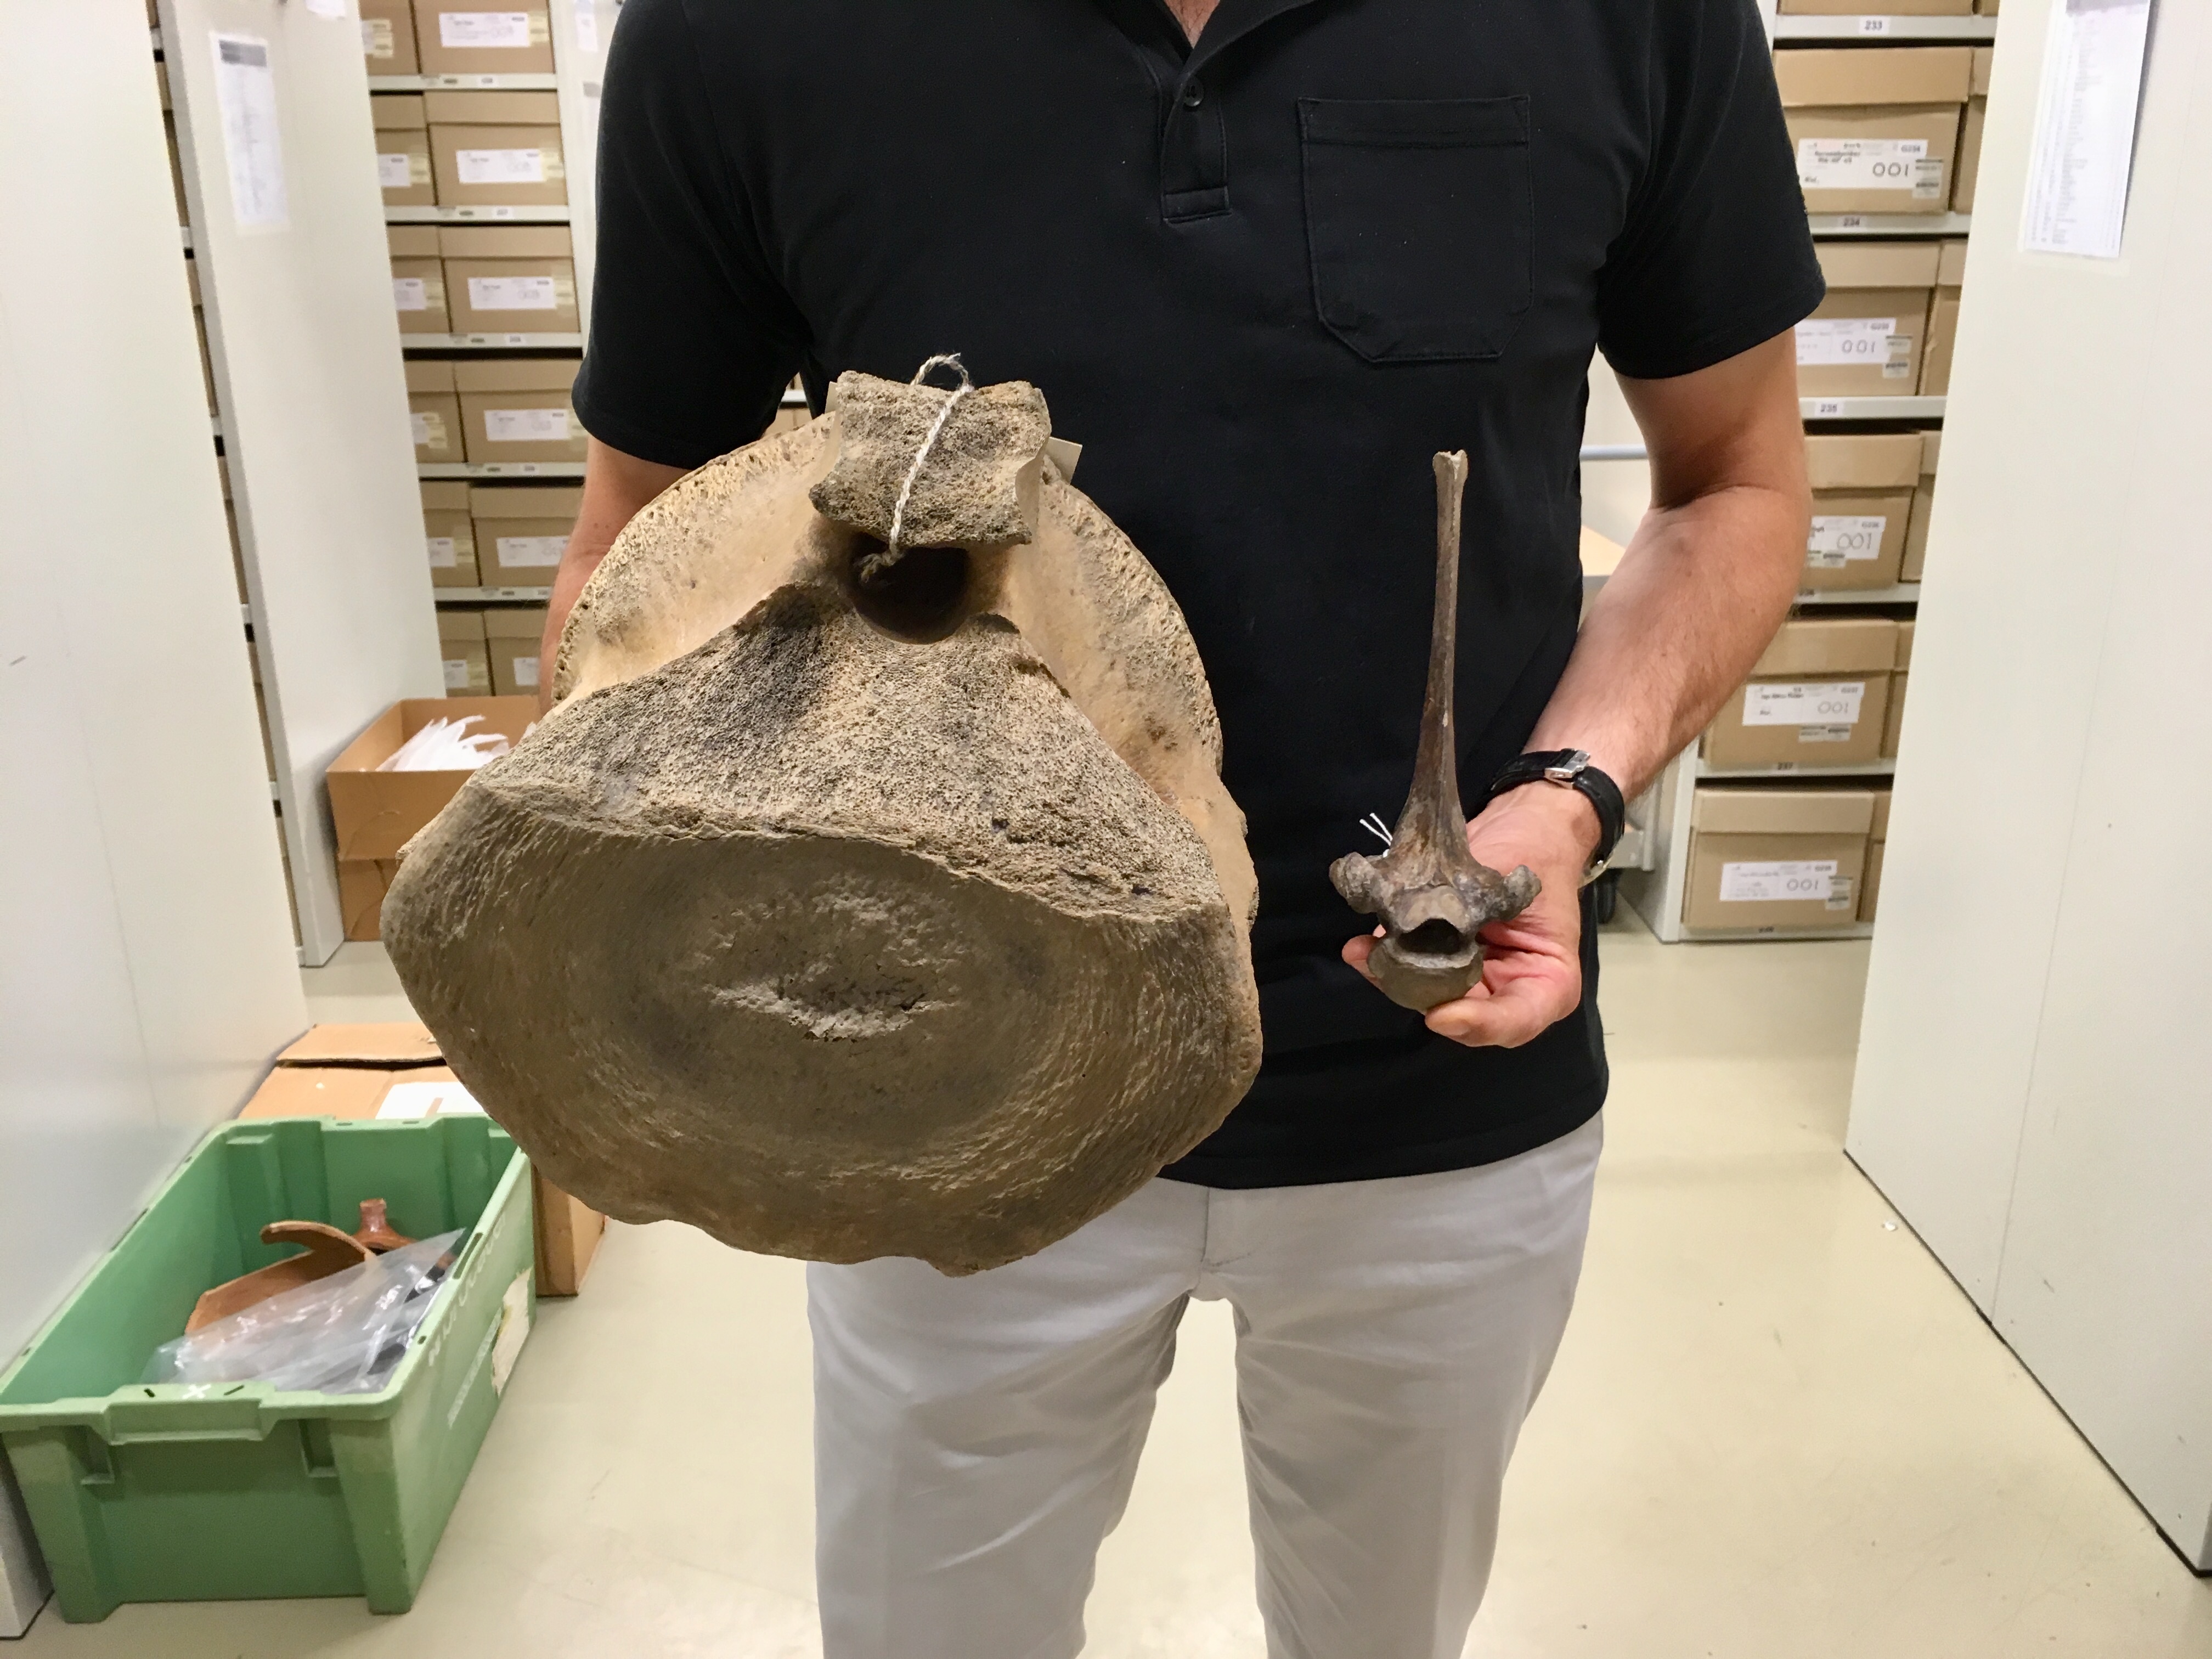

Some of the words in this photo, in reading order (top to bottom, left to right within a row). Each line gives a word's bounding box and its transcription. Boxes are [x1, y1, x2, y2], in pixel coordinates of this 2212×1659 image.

[1864, 20, 1882, 31] 233
[1872, 162, 1909, 177] 001
[1841, 339, 1875, 353] 001
[1836, 532, 1872, 550] 001
[1817, 701, 1848, 714] 001
[1786, 878, 1819, 891] 001
